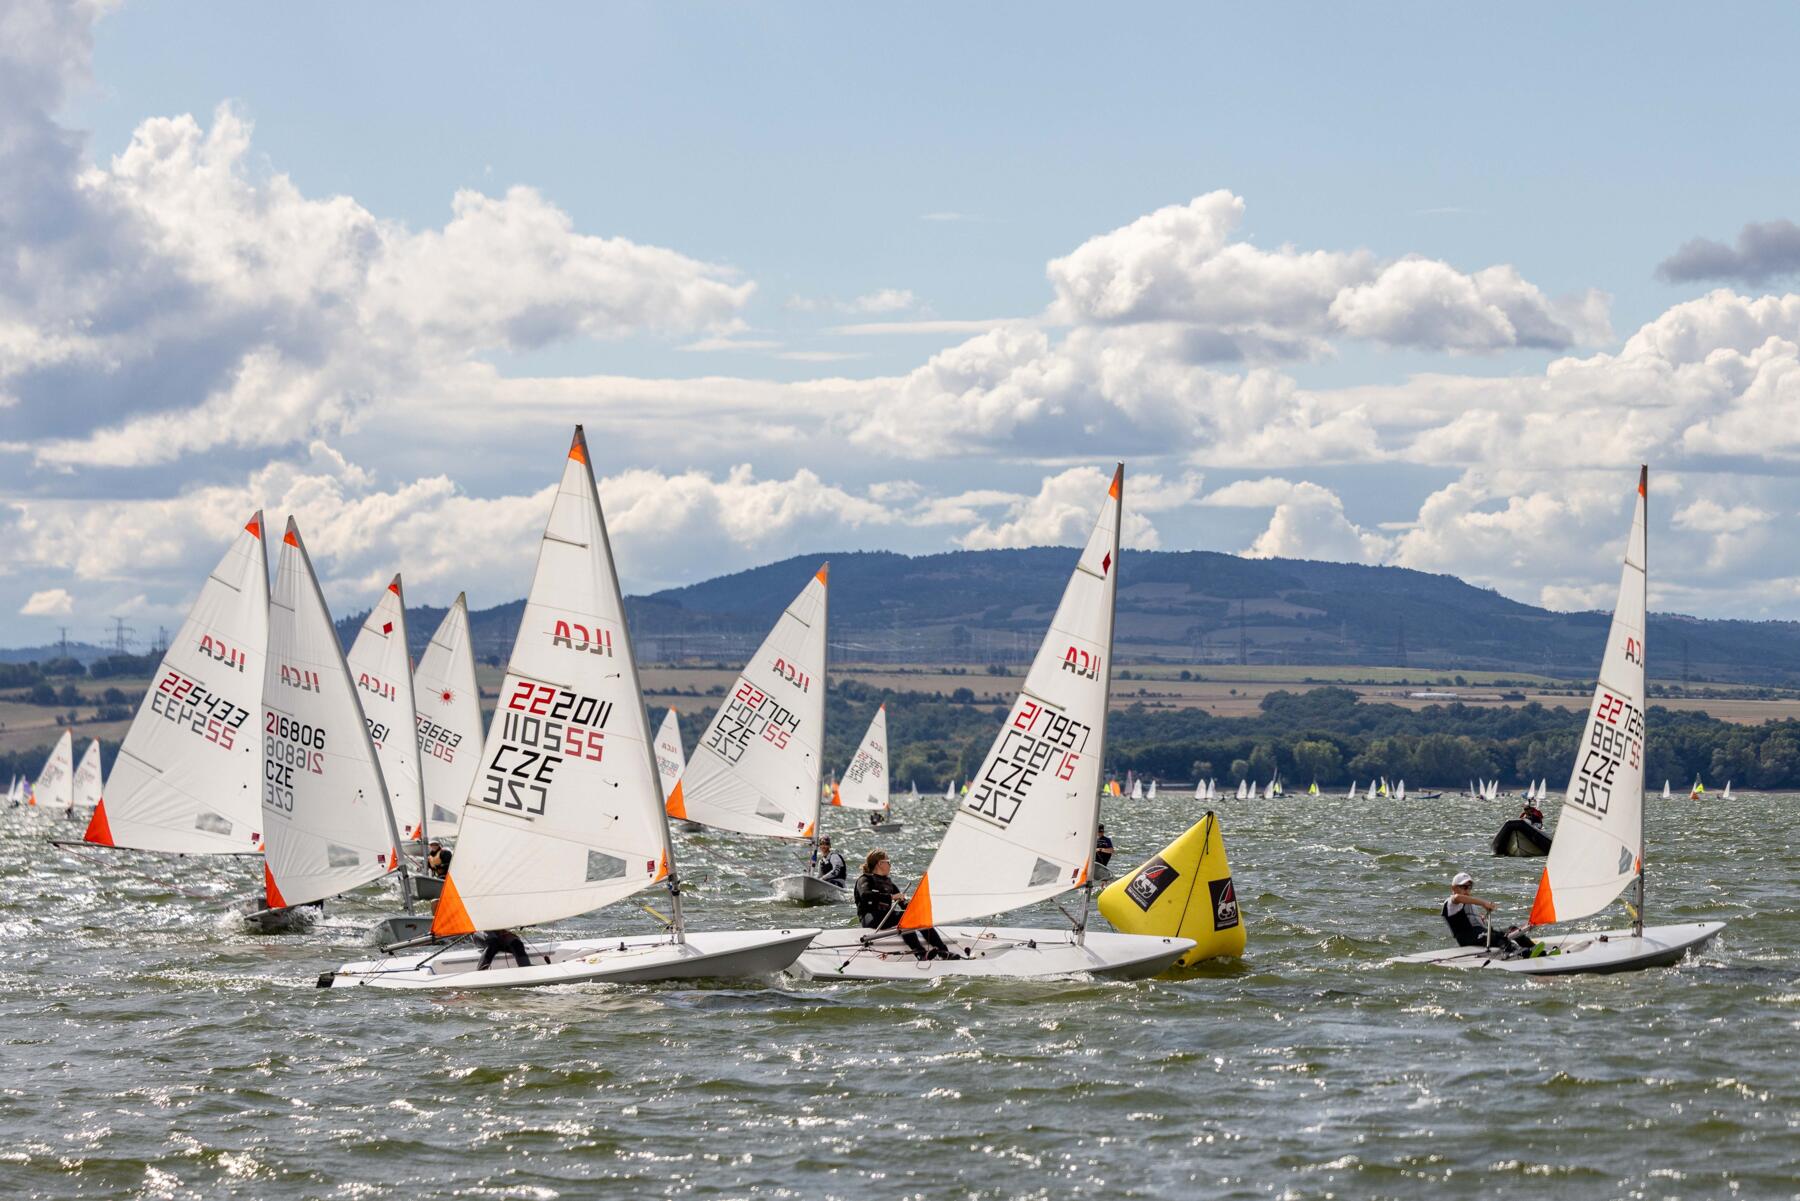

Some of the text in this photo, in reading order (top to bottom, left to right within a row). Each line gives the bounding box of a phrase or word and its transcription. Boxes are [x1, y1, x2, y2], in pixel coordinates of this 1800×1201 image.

[159, 672, 249, 728] 225433
[509, 682, 613, 729] 222011
[736, 683, 800, 733] 221704
[266, 712, 326, 749] 216806
[717, 715, 755, 746] CZE
[1014, 701, 1091, 753] 217957
[266, 760, 294, 789] CZE
[490, 745, 563, 784] CZE
[985, 757, 1038, 796] CZE
[1581, 750, 1620, 785] CZE
